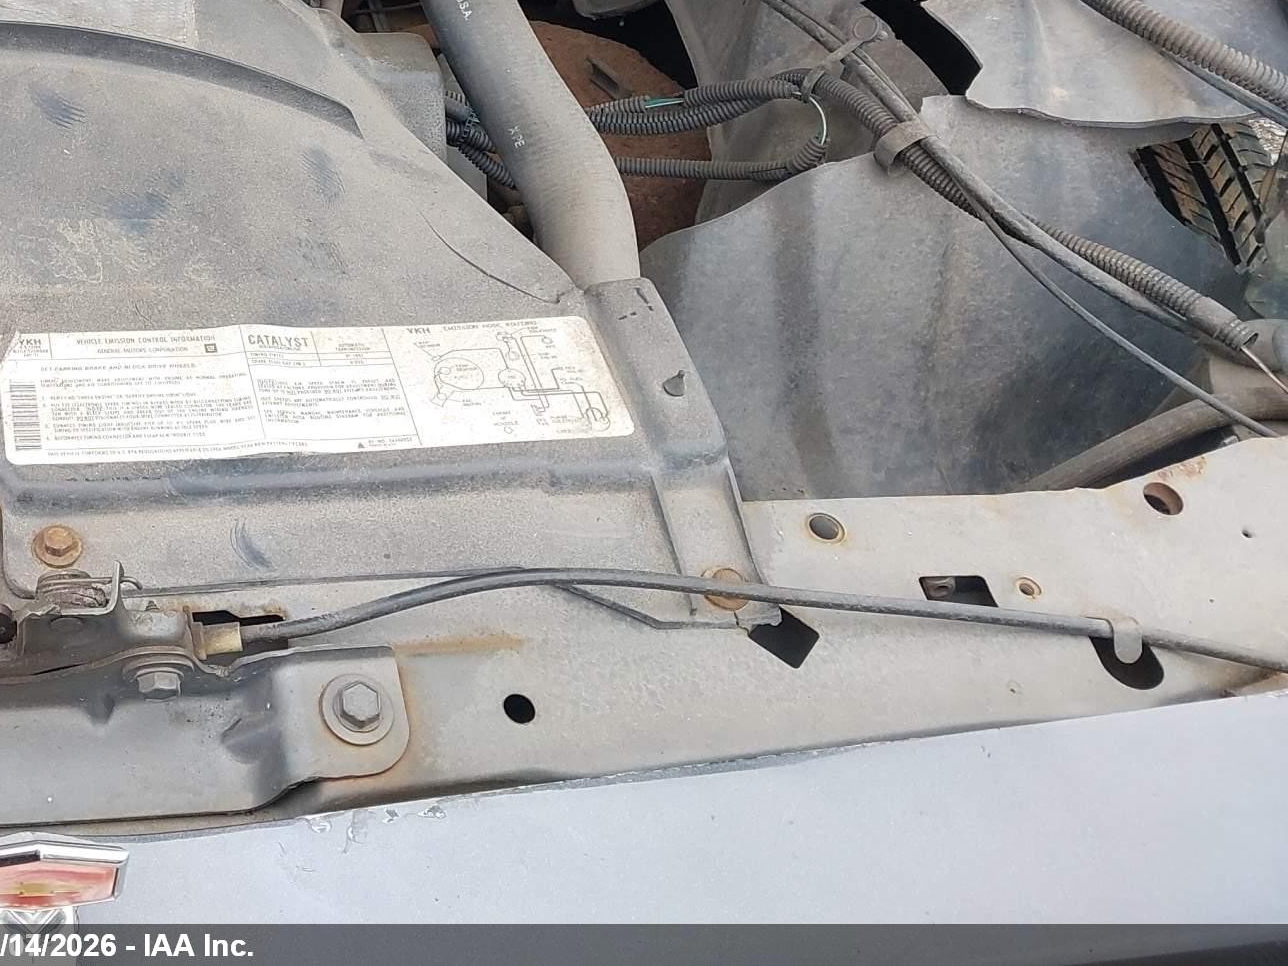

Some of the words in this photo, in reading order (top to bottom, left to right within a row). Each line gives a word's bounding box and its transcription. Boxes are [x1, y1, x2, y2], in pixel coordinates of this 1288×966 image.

[406, 327, 431, 335] YKH
[138, 336, 168, 344] CONTROL
[247, 333, 309, 347] CATALYST
